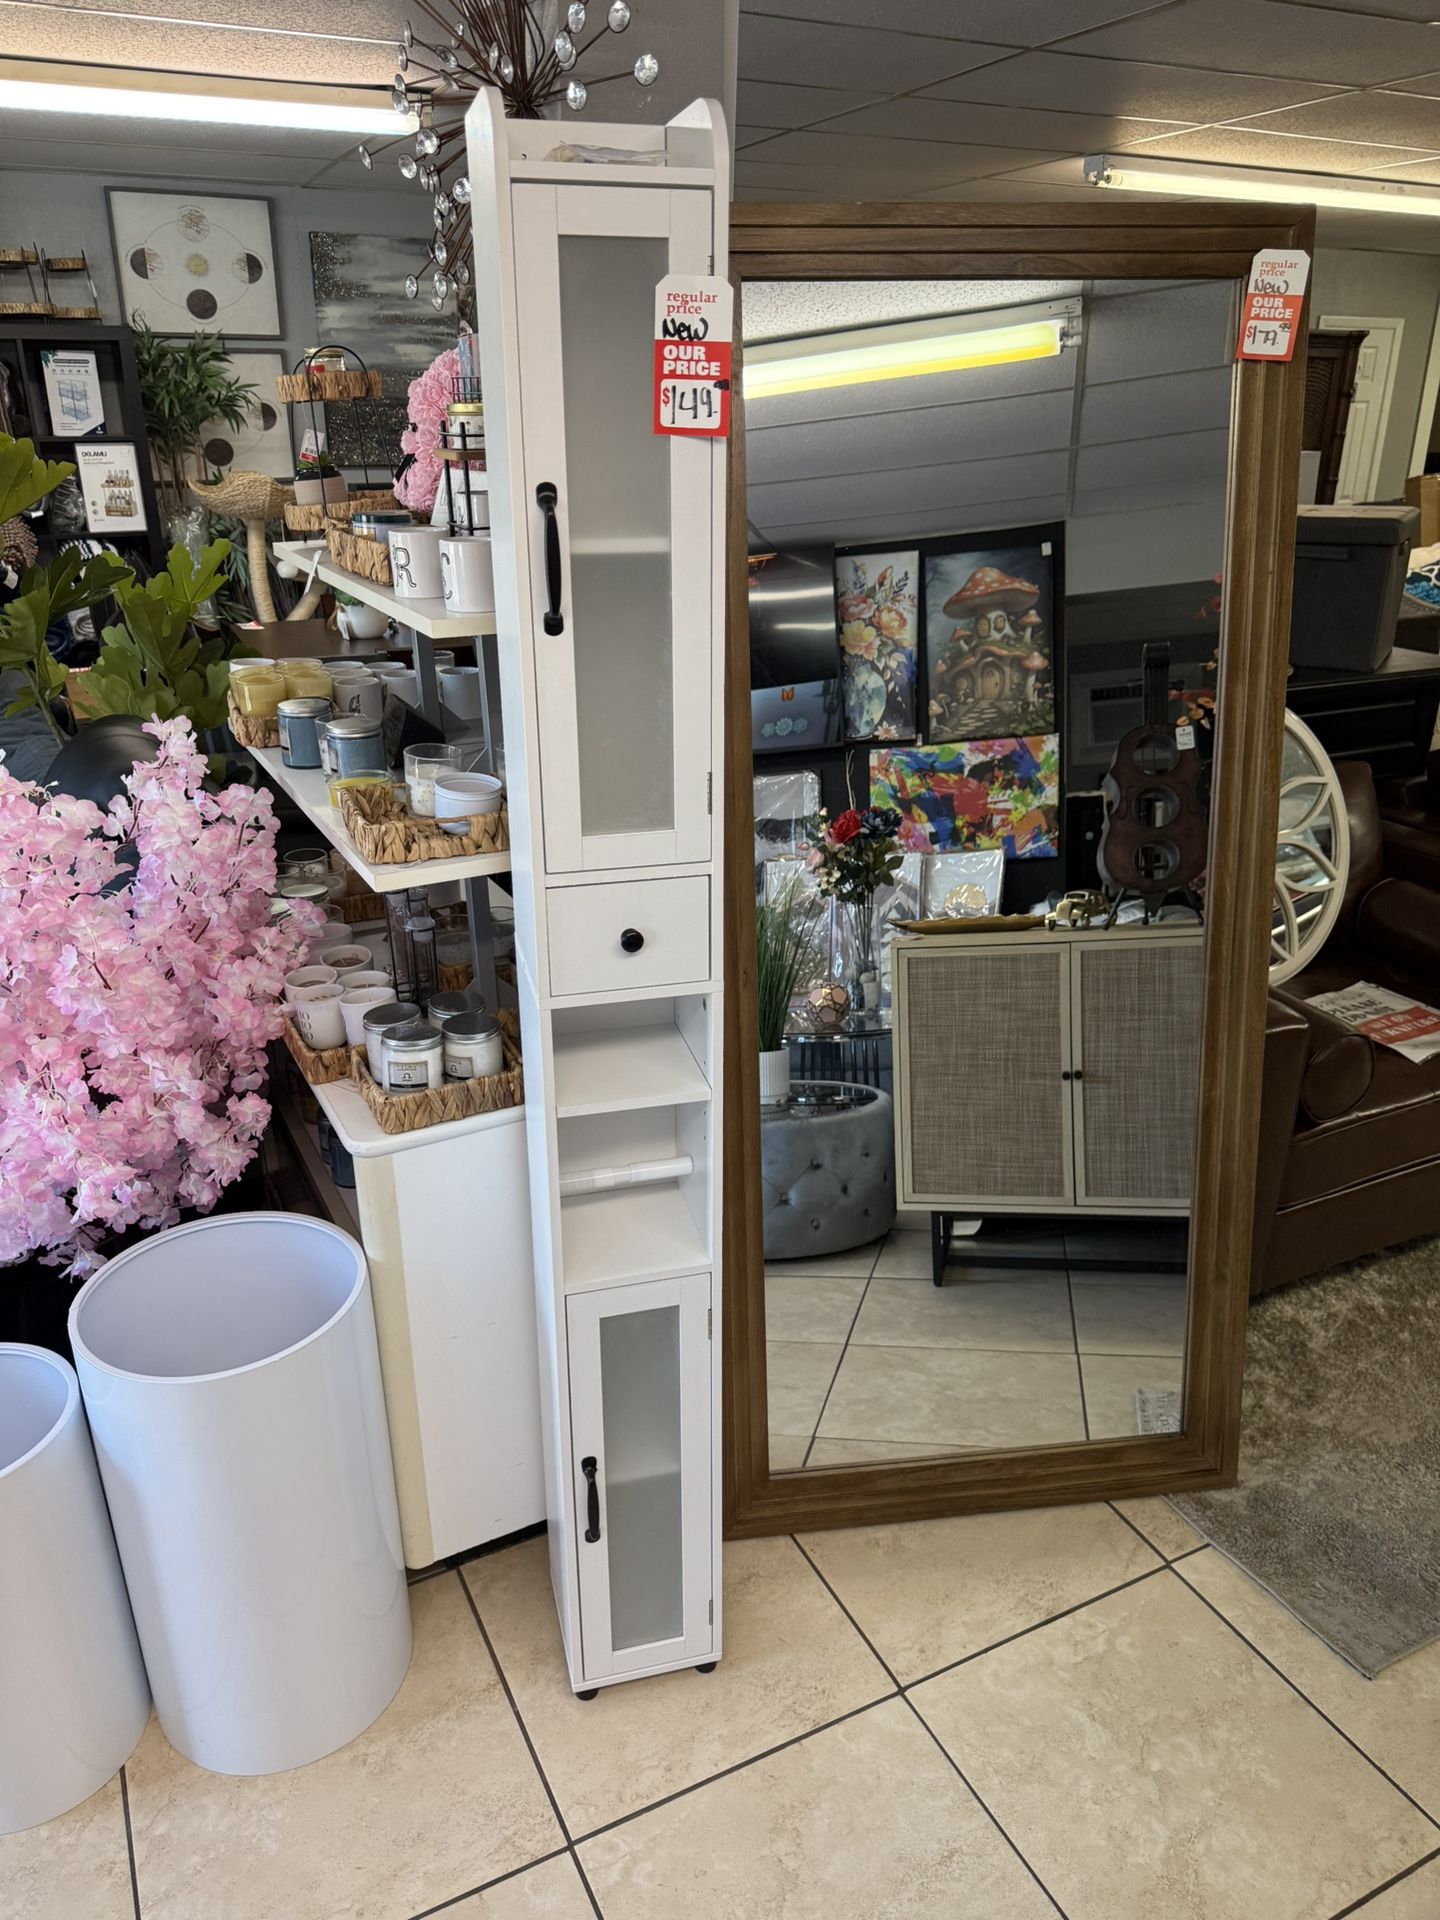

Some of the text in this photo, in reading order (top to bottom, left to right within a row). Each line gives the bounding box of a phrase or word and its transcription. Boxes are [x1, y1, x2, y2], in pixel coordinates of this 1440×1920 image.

[1261, 260, 1298, 270] regular
[1259, 268, 1286, 278] price
[666, 291, 718, 305] regular
[1252, 296, 1283, 308] OUR
[666, 302, 702, 317] price
[1250, 307, 1294, 319] PRICE
[663, 345, 706, 360] OUR
[663, 360, 721, 376] PRICE
[392, 545, 417, 588] R
